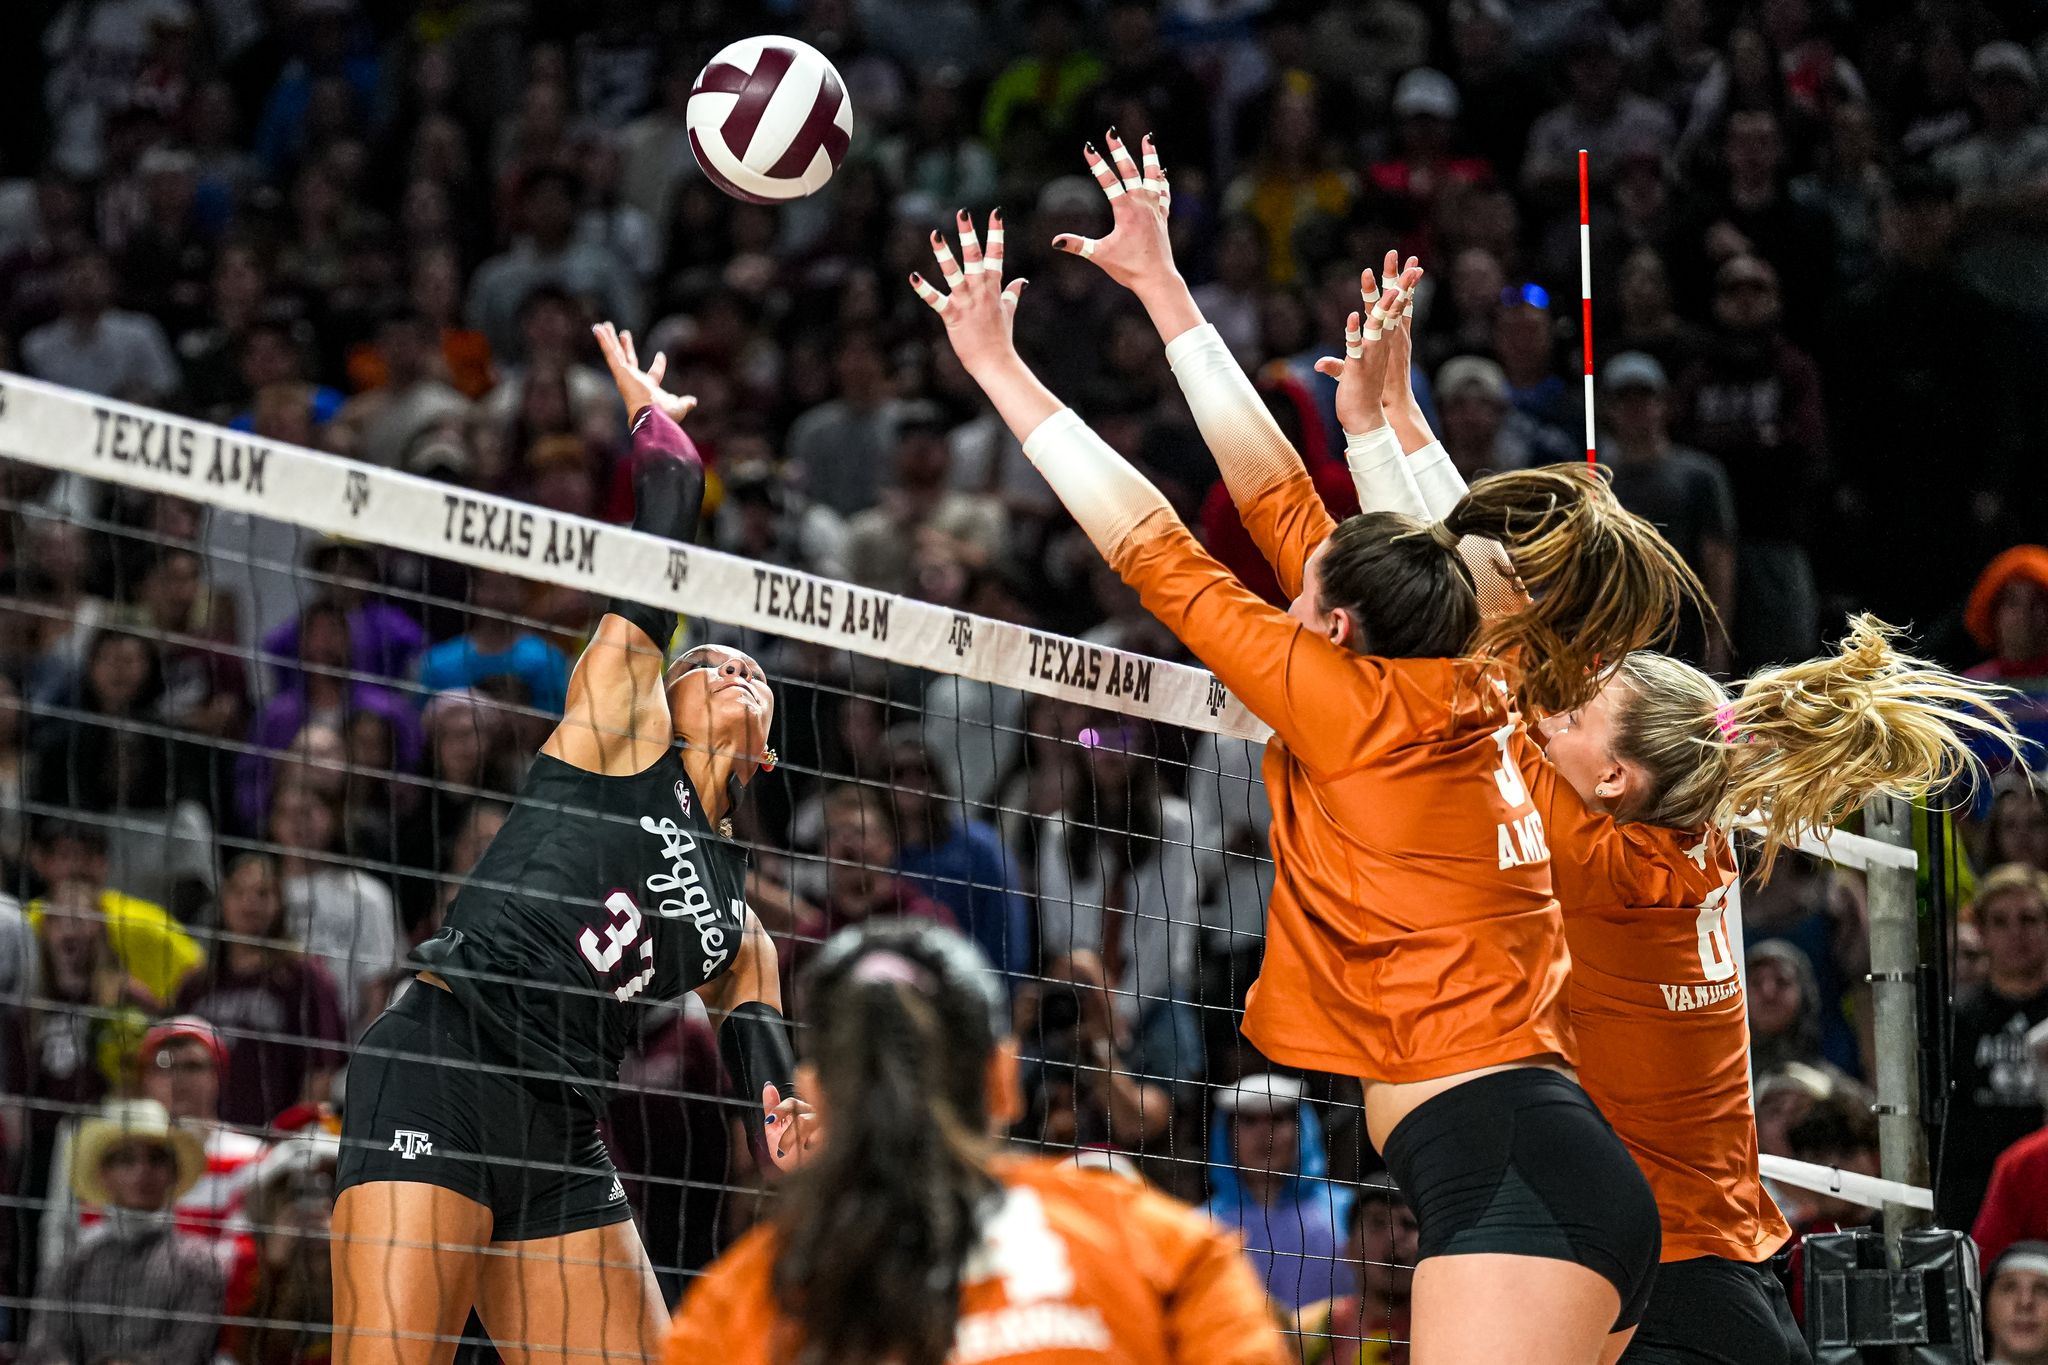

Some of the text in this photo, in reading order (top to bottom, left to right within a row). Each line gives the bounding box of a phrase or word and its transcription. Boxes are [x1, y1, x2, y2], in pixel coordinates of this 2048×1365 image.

[93, 406, 271, 495] TEXAS A&M
[444, 495, 598, 574] TEXAS A&M
[754, 569, 890, 642] TEXAS A&M
[1028, 633, 1153, 704] TEXAS A&M
[639, 815, 729, 980] Aggies
[1694, 885, 1736, 982] 0
[576, 888, 656, 1003] 31
